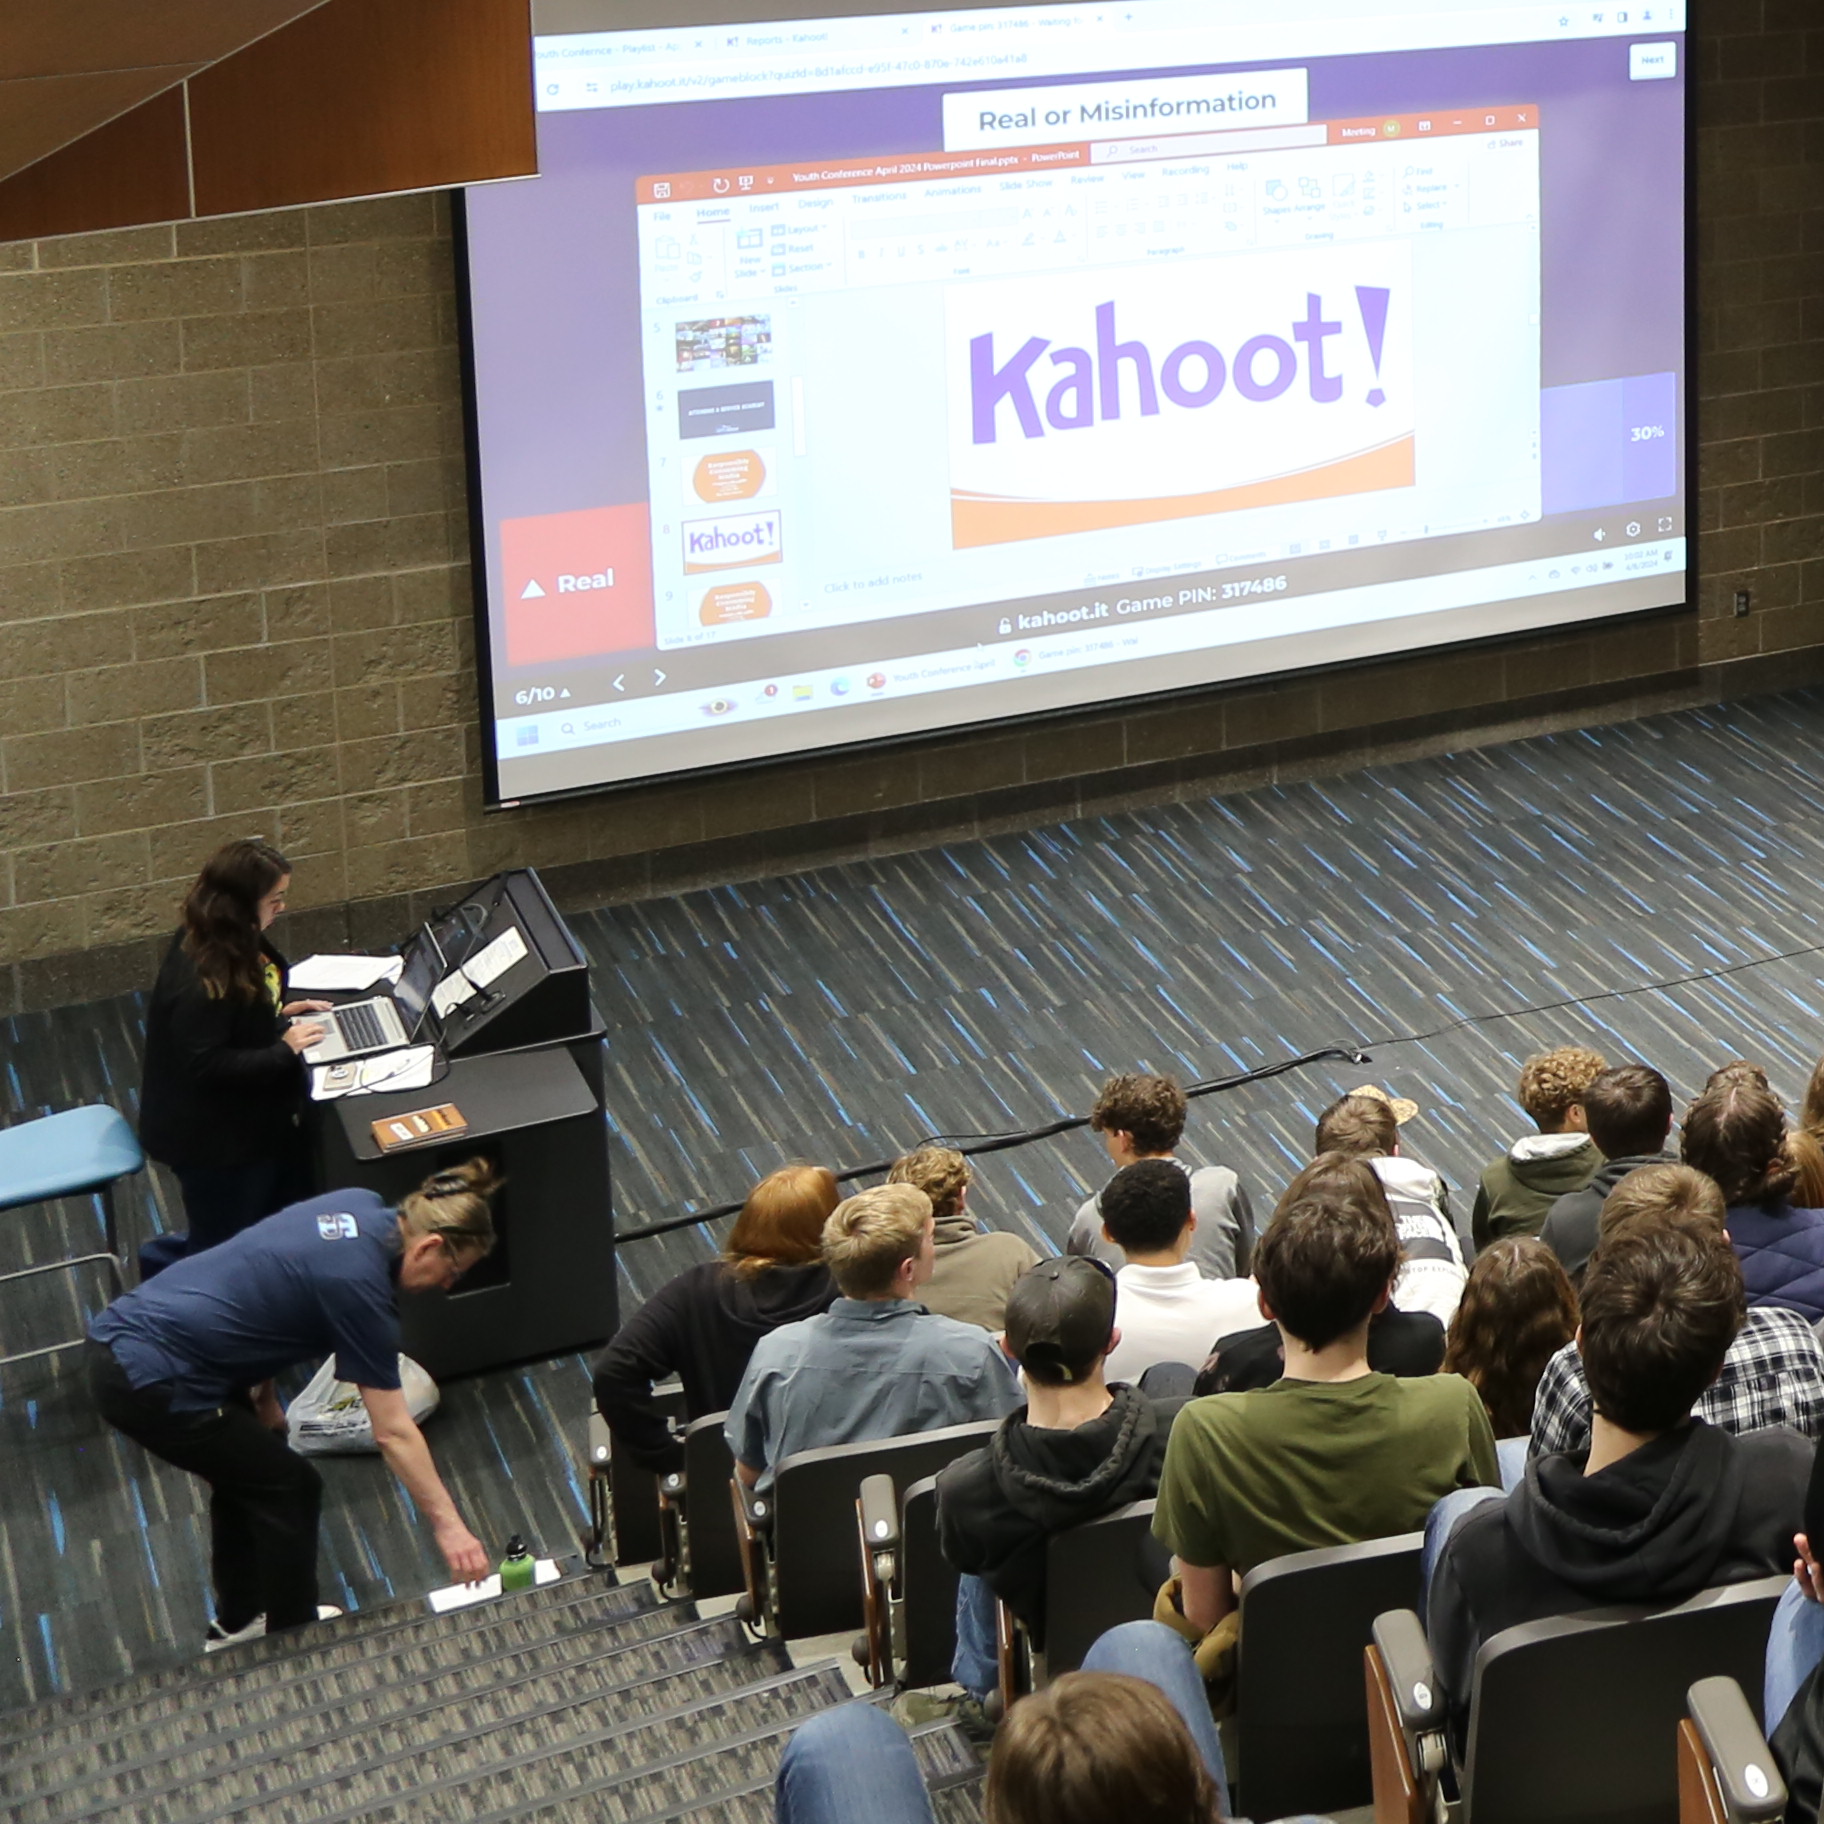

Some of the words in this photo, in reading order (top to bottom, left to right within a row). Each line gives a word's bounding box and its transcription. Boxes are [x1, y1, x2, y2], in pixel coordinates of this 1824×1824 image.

[950, 21, 975, 33] Game
[997, 19, 1030, 31] 317486
[1038, 17, 1072, 29] Waiting
[746, 34, 783, 48] Reports
[622, 42, 656, 55] Playlist
[1641, 55, 1665, 65] Next
[978, 107, 1036, 131] Real
[1044, 109, 1071, 126] or
[1079, 89, 1277, 124] Misinformation
[1341, 125, 1376, 138] Meeting
[1129, 143, 1158, 155] Search
[1499, 137, 1524, 148] Share
[792, 170, 820, 183] Youth
[820, 166, 874, 181] Conference
[875, 163, 899, 177] April
[899, 161, 922, 175] 2024
[923, 158, 974, 173] Powerpoint
[975, 155, 1019, 170] Final.pptx
[1031, 149, 1080, 164] PowerPoint
[653, 210, 671, 222] File
[696, 206, 731, 219] Home
[749, 201, 780, 213] Insert
[797, 198, 834, 212] Design
[851, 191, 907, 205] Transitions
[924, 183, 982, 198] Animations
[998, 180, 1023, 192] Slide
[1025, 178, 1054, 189] Show
[1070, 173, 1105, 185] Review
[1121, 169, 1146, 181] View
[1161, 164, 1210, 179] Recording
[1227, 161, 1249, 174] Help
[1262, 204, 1292, 217] Shapes
[1416, 199, 1441, 211] Select
[787, 224, 819, 237] Layout
[788, 242, 814, 254] Reset
[739, 254, 762, 266] New
[734, 267, 758, 279] Slide
[788, 261, 824, 274] Section
[656, 292, 699, 306] Clipboard
[968, 283, 1391, 445] Kahoot!
[1630, 424, 1665, 442] 30%
[659, 456, 667, 467] 7
[689, 520, 775, 554] Kahoot!
[558, 567, 614, 593] Real
[824, 580, 850, 595] Click
[852, 578, 865, 591] to
[867, 575, 890, 589] add
[892, 571, 922, 585] notes
[1017, 602, 1110, 631] kahoot.it
[1115, 596, 1174, 616] Game
[1178, 586, 1217, 606] PIN:
[1221, 574, 1288, 599] 317486
[1038, 646, 1064, 660] Game
[1084, 639, 1114, 654] 317486
[893, 670, 919, 684] Youth
[920, 663, 972, 680] Conference
[973, 658, 996, 673] April
[515, 686, 555, 706] 6/10
[583, 717, 622, 732] Search
